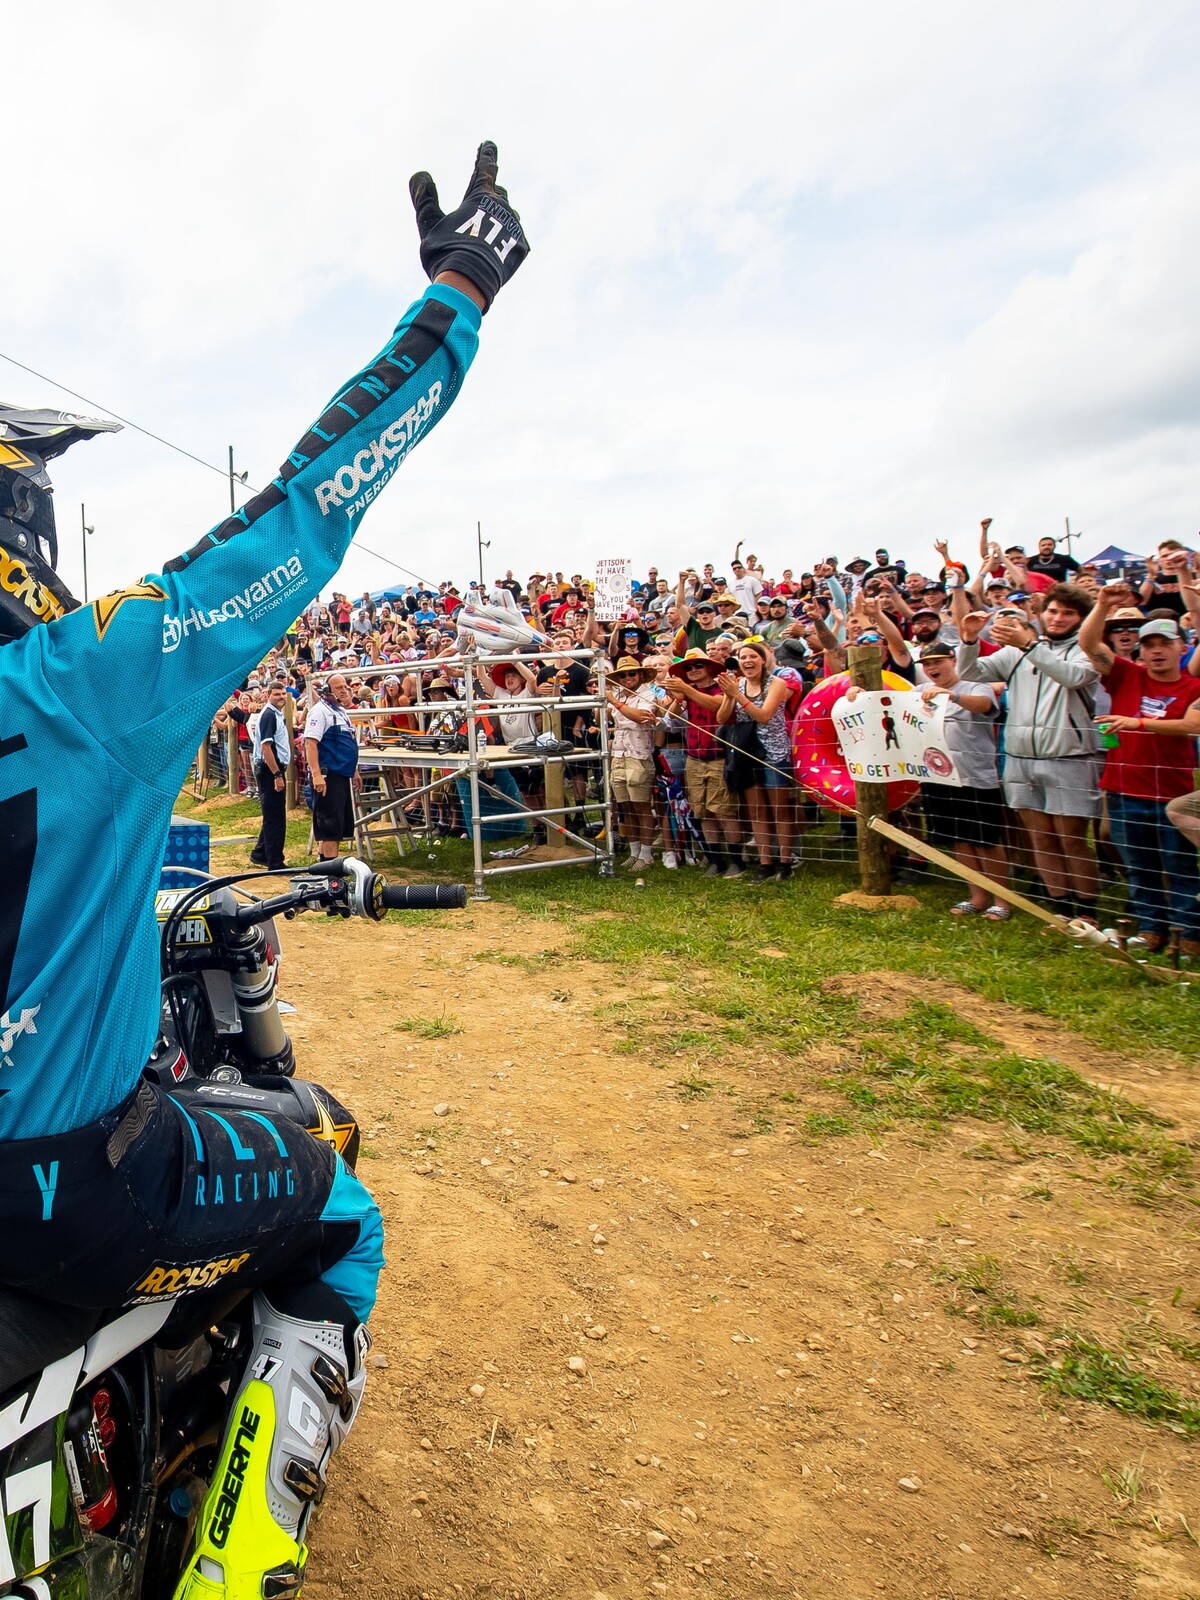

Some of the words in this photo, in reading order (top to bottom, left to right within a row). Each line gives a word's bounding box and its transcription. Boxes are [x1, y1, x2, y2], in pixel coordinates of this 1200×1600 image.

[455, 208, 518, 264] FLY
[314, 380, 443, 515] ROCKSTAR
[597, 559, 625, 567] JETTSON
[183, 555, 304, 635] Husqvarna
[250, 590, 284, 623] FACTORY
[285, 576, 309, 601] RACING
[849, 762, 863, 775] GO
[867, 764, 890, 777] GET
[897, 762, 930, 777] YOUR
[196, 1086, 230, 1096] FC
[196, 1168, 295, 1206] RACING
[252, 1353, 284, 1382] 47
